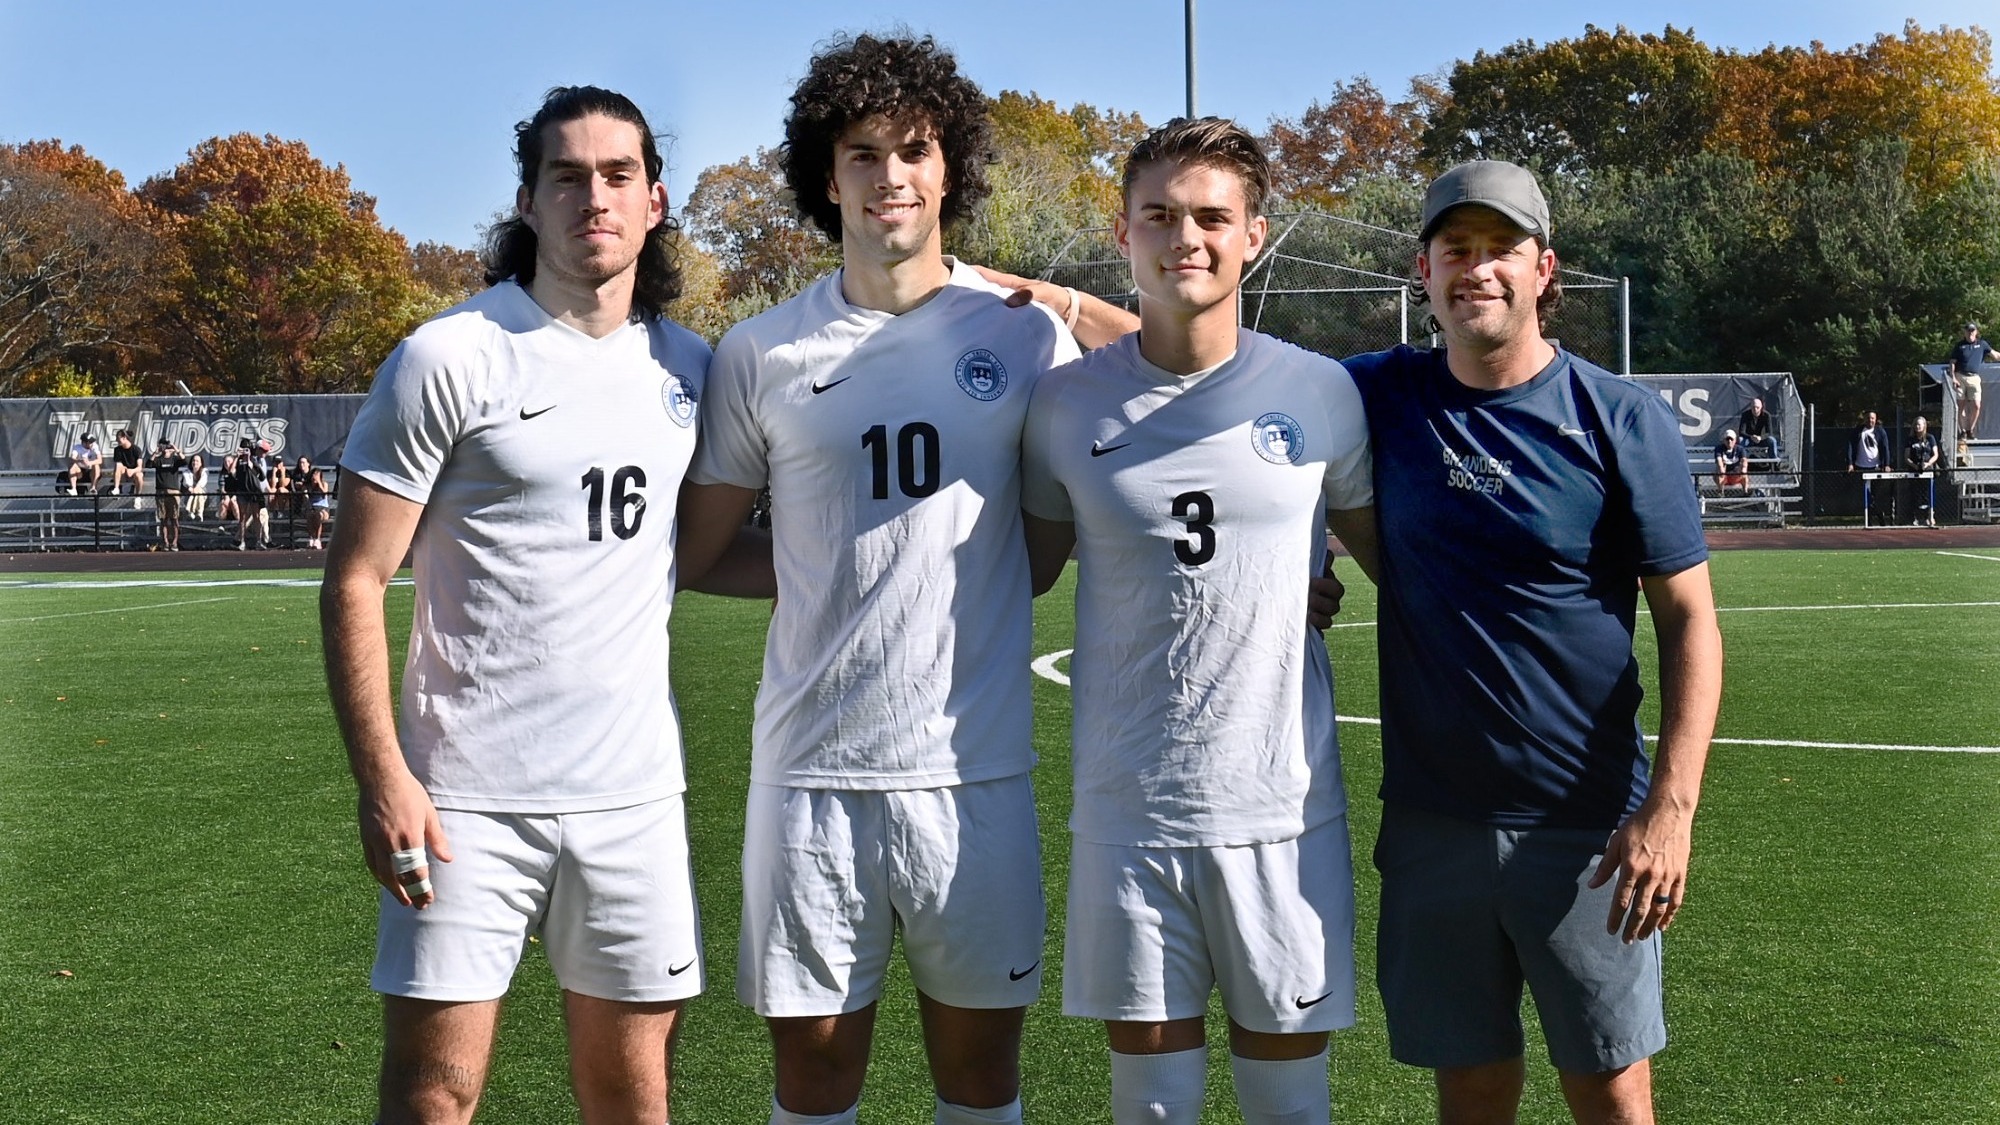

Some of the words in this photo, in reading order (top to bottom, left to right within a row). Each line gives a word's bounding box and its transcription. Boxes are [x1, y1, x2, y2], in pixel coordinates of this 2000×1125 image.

[160, 401, 219, 415] WOMEN'S
[220, 403, 269, 415] SOCCER
[861, 421, 940, 500] 10
[1442, 447, 1513, 477] BRANDEIS
[1447, 468, 1504, 496] SOCCER
[581, 464, 647, 542] 16
[1171, 490, 1217, 567] 3
